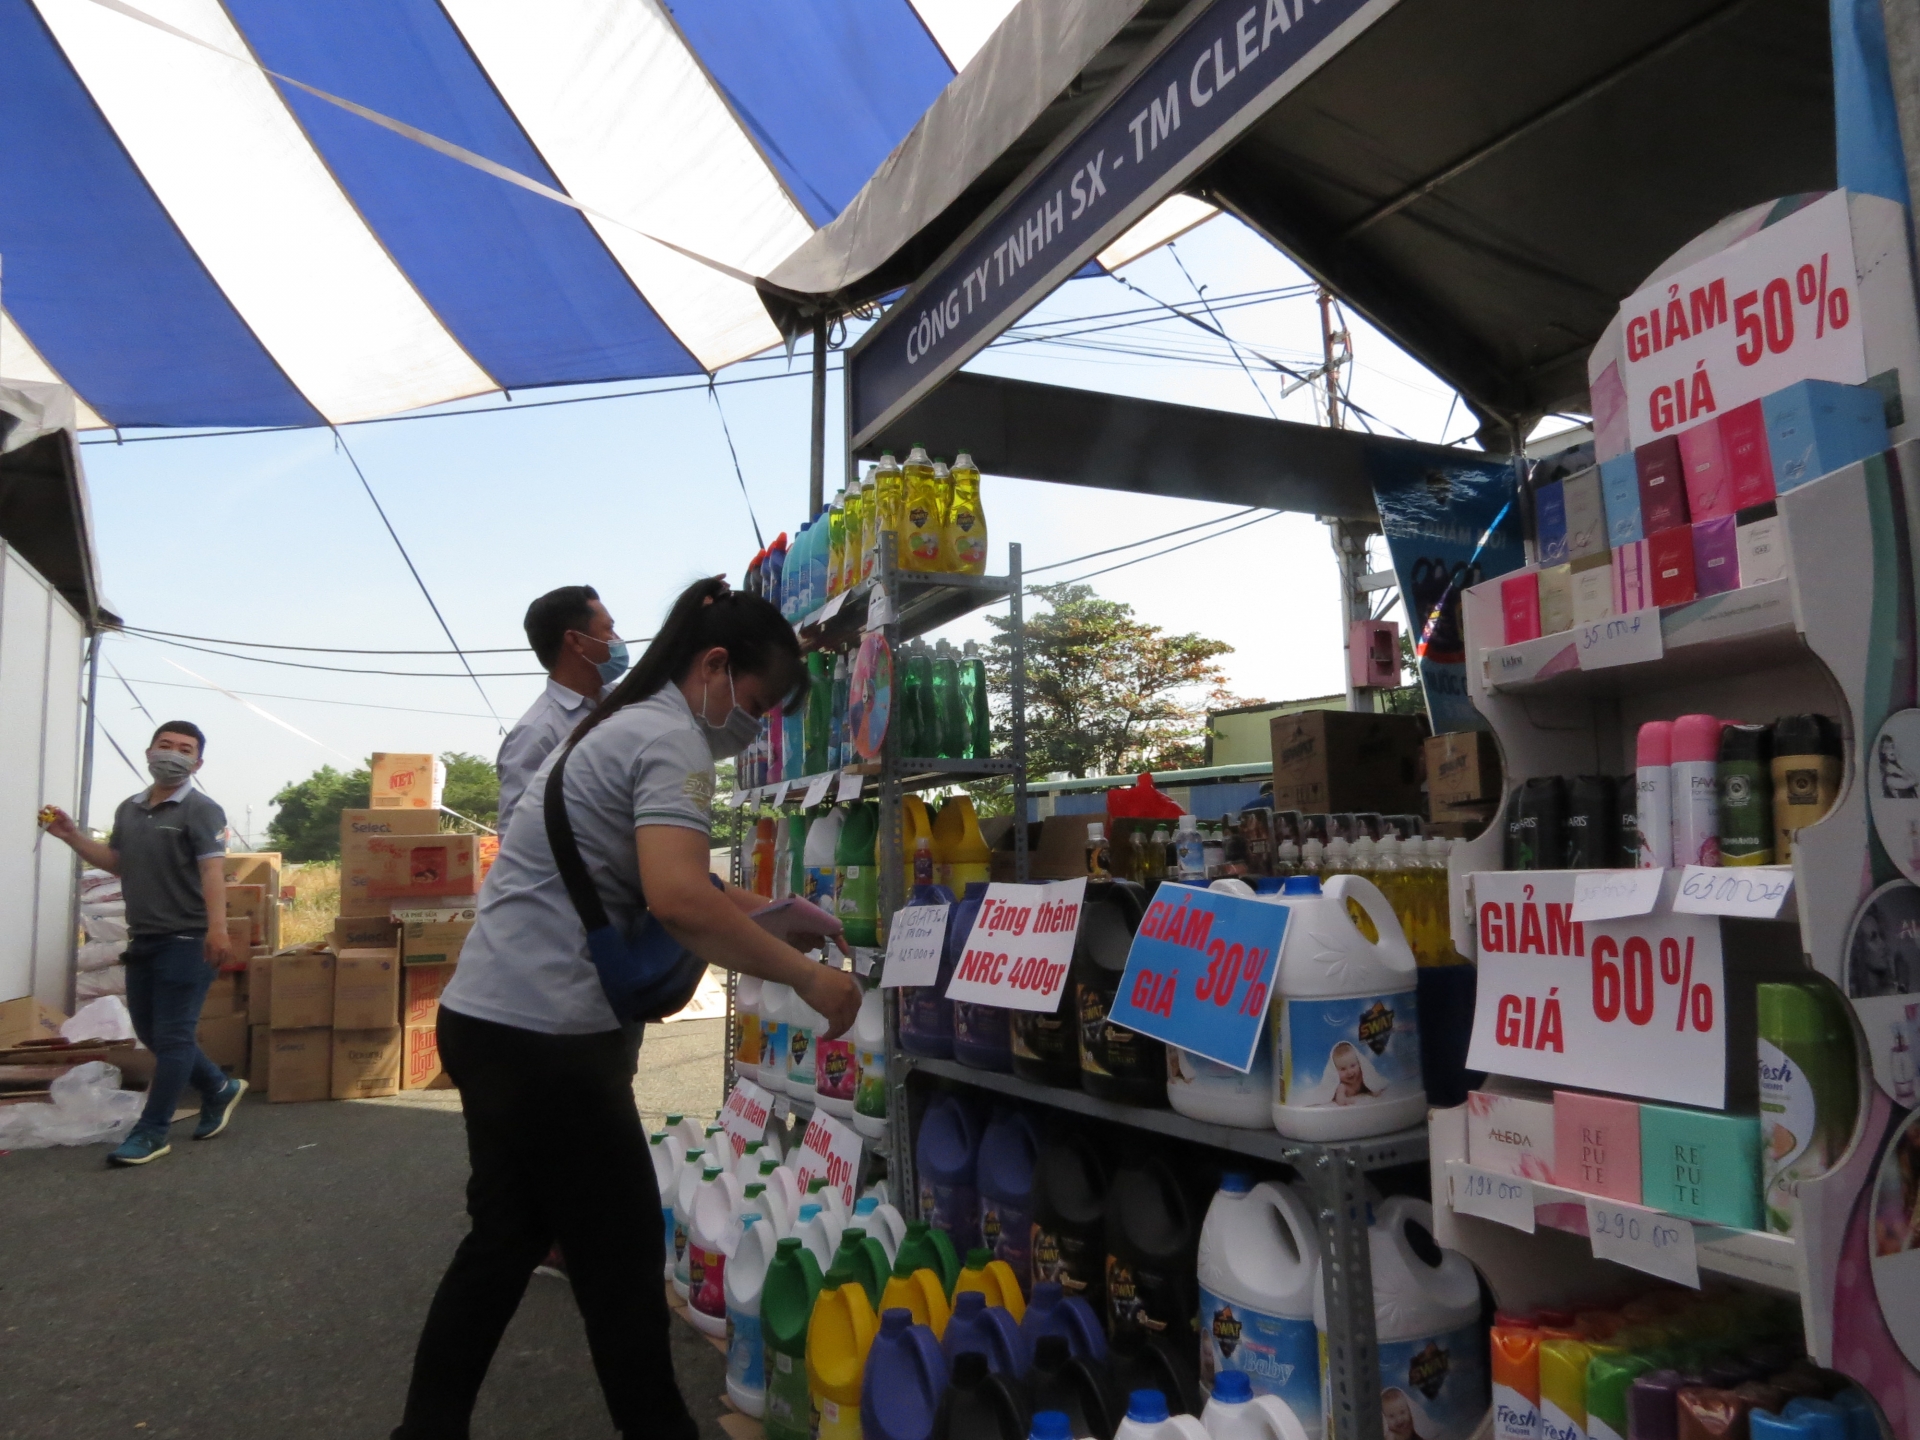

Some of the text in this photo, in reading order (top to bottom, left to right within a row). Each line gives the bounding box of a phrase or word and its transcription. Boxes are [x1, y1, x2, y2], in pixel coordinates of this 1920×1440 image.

[906, 292, 962, 364] CÔNG
[963, 264, 990, 317] TY
[992, 189, 1065, 289] TNHH
[1070, 149, 1108, 221] SX
[1128, 79, 1181, 165] TM
[1625, 252, 1850, 367] GIẢM 50%
[1648, 358, 1718, 432] GIÁ
[389, 771, 415, 789] NET
[351, 822, 393, 834] Select
[977, 898, 1079, 937] Tặng thêm
[1140, 893, 1269, 1018] GIẢM 30%
[1479, 883, 1714, 1033] GIẢM 60%
[957, 949, 1067, 996] NRC 400gr
[1130, 968, 1179, 1018] GIÁ
[1359, 1010, 1395, 1040] SWAT
[1495, 986, 1565, 1054] GIÁ
[725, 1085, 748, 1118] Tặng
[743, 1096, 768, 1130] thêm
[1488, 1128, 1532, 1148] ALEDA
[1583, 1127, 1603, 1147] RE
[803, 1118, 853, 1207] GIẢM 30%
[1583, 1146, 1606, 1164] PU
[1675, 1144, 1699, 1166] RE
[1583, 1164, 1604, 1184] TE
[1676, 1165, 1701, 1185] PU
[1675, 1185, 1700, 1206] TE
[1111, 1282, 1137, 1298] SWAT
[1213, 1320, 1242, 1340] SWAT
[1243, 1350, 1295, 1386] Baby
[1497, 1405, 1536, 1427] Fresh
